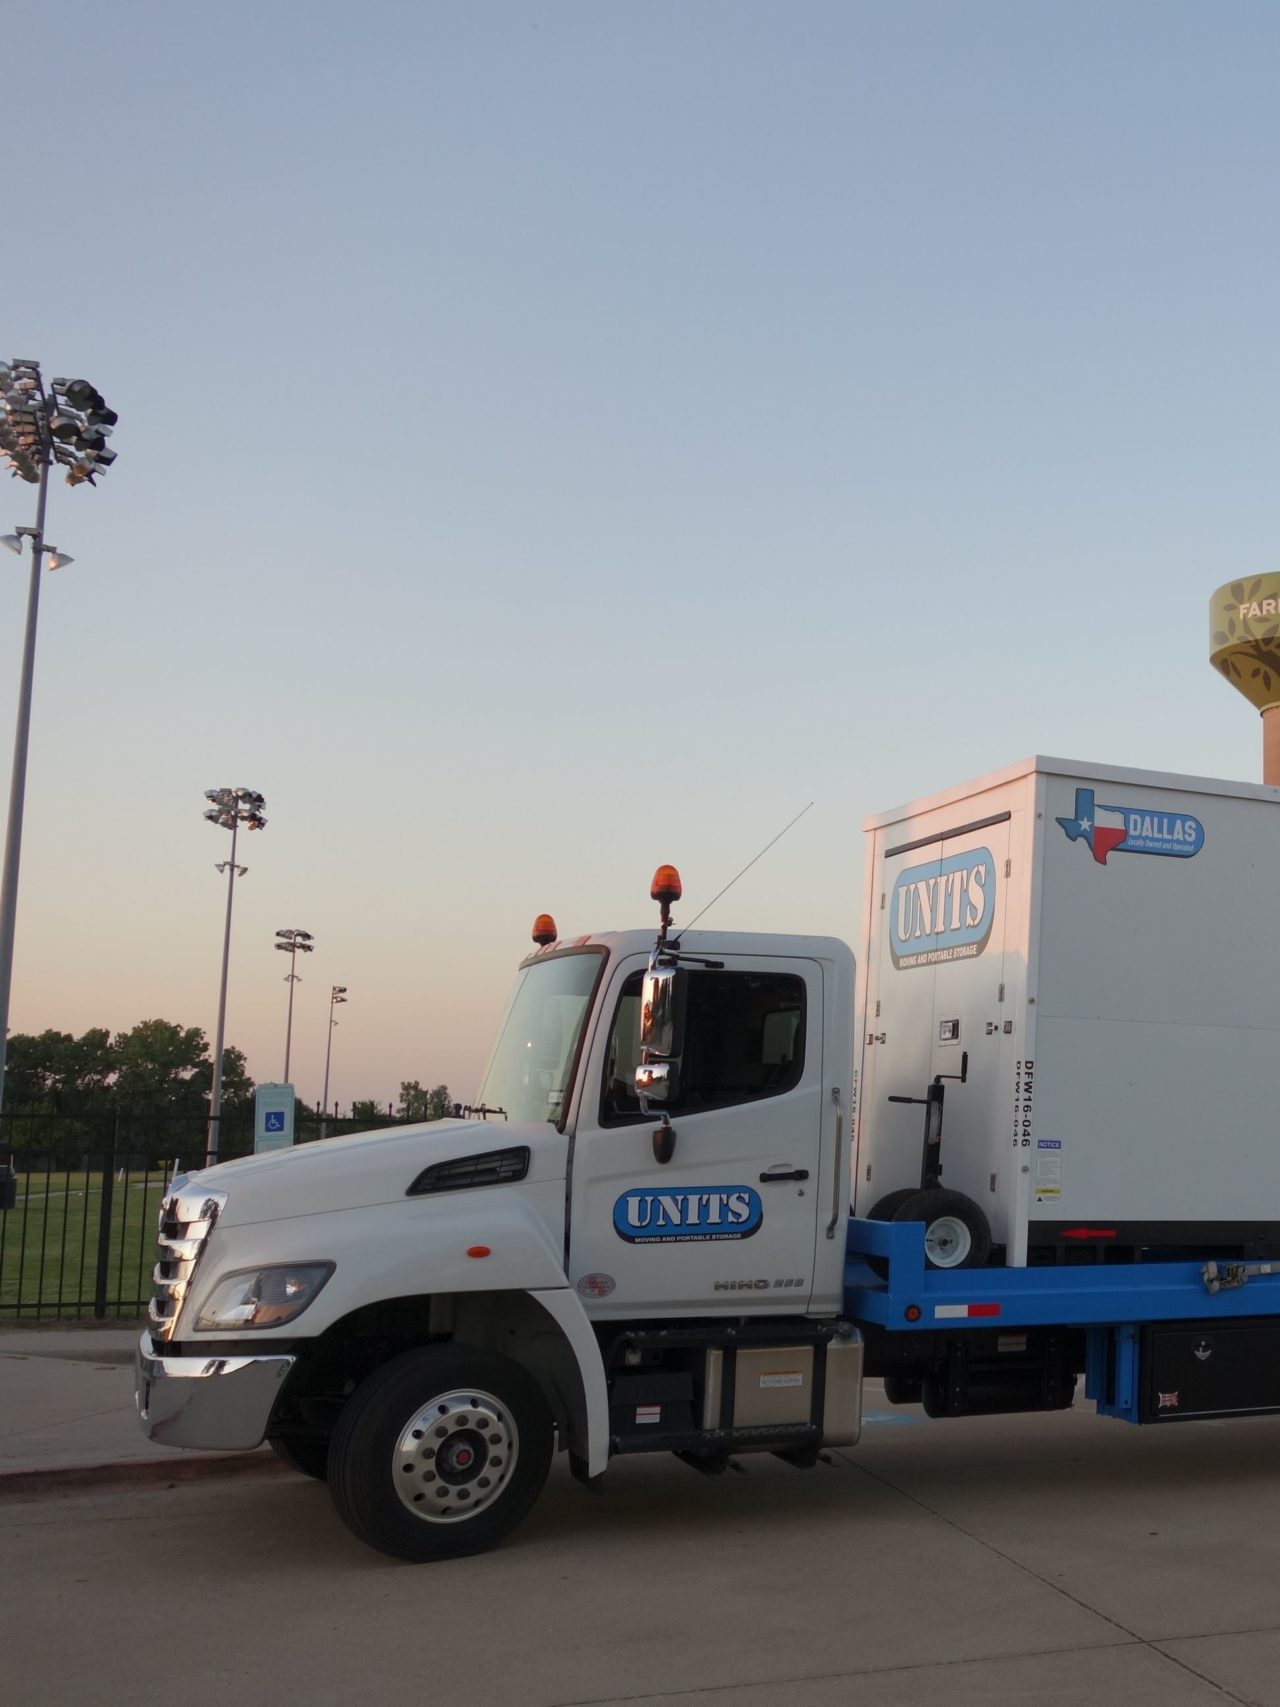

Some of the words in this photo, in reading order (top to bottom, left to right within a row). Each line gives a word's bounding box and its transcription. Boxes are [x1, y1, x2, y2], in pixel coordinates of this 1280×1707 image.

[1129, 814, 1197, 842] DALLAS
[897, 863, 987, 943] UNITS
[899, 955, 917, 968] MOVING
[917, 953, 927, 964] AND
[927, 948, 953, 962] PORTABLE
[953, 944, 978, 958] STORAGE
[1021, 1060, 1034, 1147] DFW16-046
[626, 1192, 751, 1227] UNITS
[634, 1236, 661, 1244] MOVING
[662, 1235, 676, 1243] AND
[677, 1234, 711, 1242] PORTABLE
[711, 1233, 742, 1241] STORAGE
[713, 1279, 770, 1291] HINO
